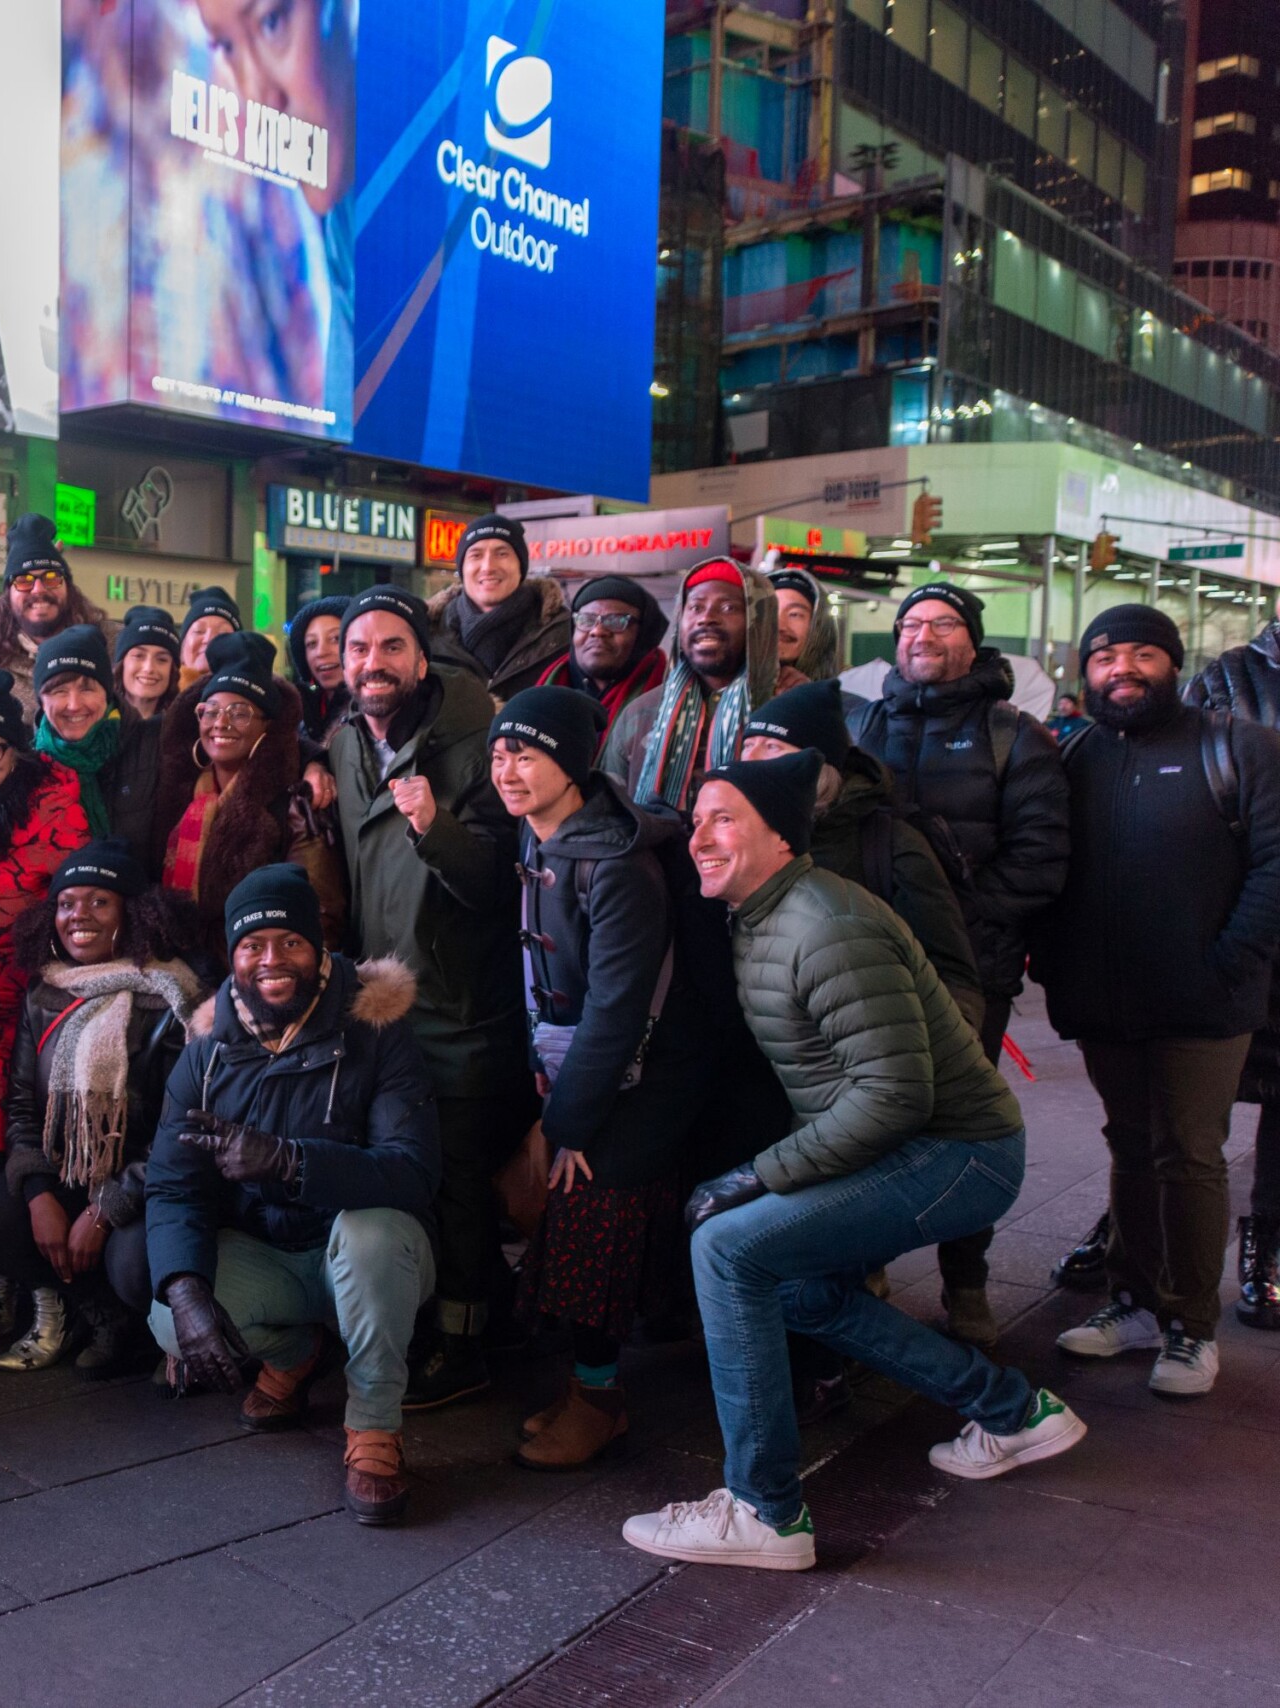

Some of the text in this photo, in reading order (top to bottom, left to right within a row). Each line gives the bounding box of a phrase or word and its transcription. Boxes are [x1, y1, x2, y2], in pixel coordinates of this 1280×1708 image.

[170, 69, 239, 157] HELL'S
[244, 99, 328, 190] KITCHEN
[436, 139, 590, 237] Clear Channel
[470, 206, 558, 274] Outdoor
[286, 488, 415, 540] BLUE FIN
[545, 528, 714, 559] PHOTOGRAPHY
[48, 661, 58, 669] ART
[80, 659, 96, 669] WORK
[500, 722, 559, 749] ART TAKES WORK
[767, 724, 789, 736] WORK
[233, 910, 287, 931] ART TAKES WORK
